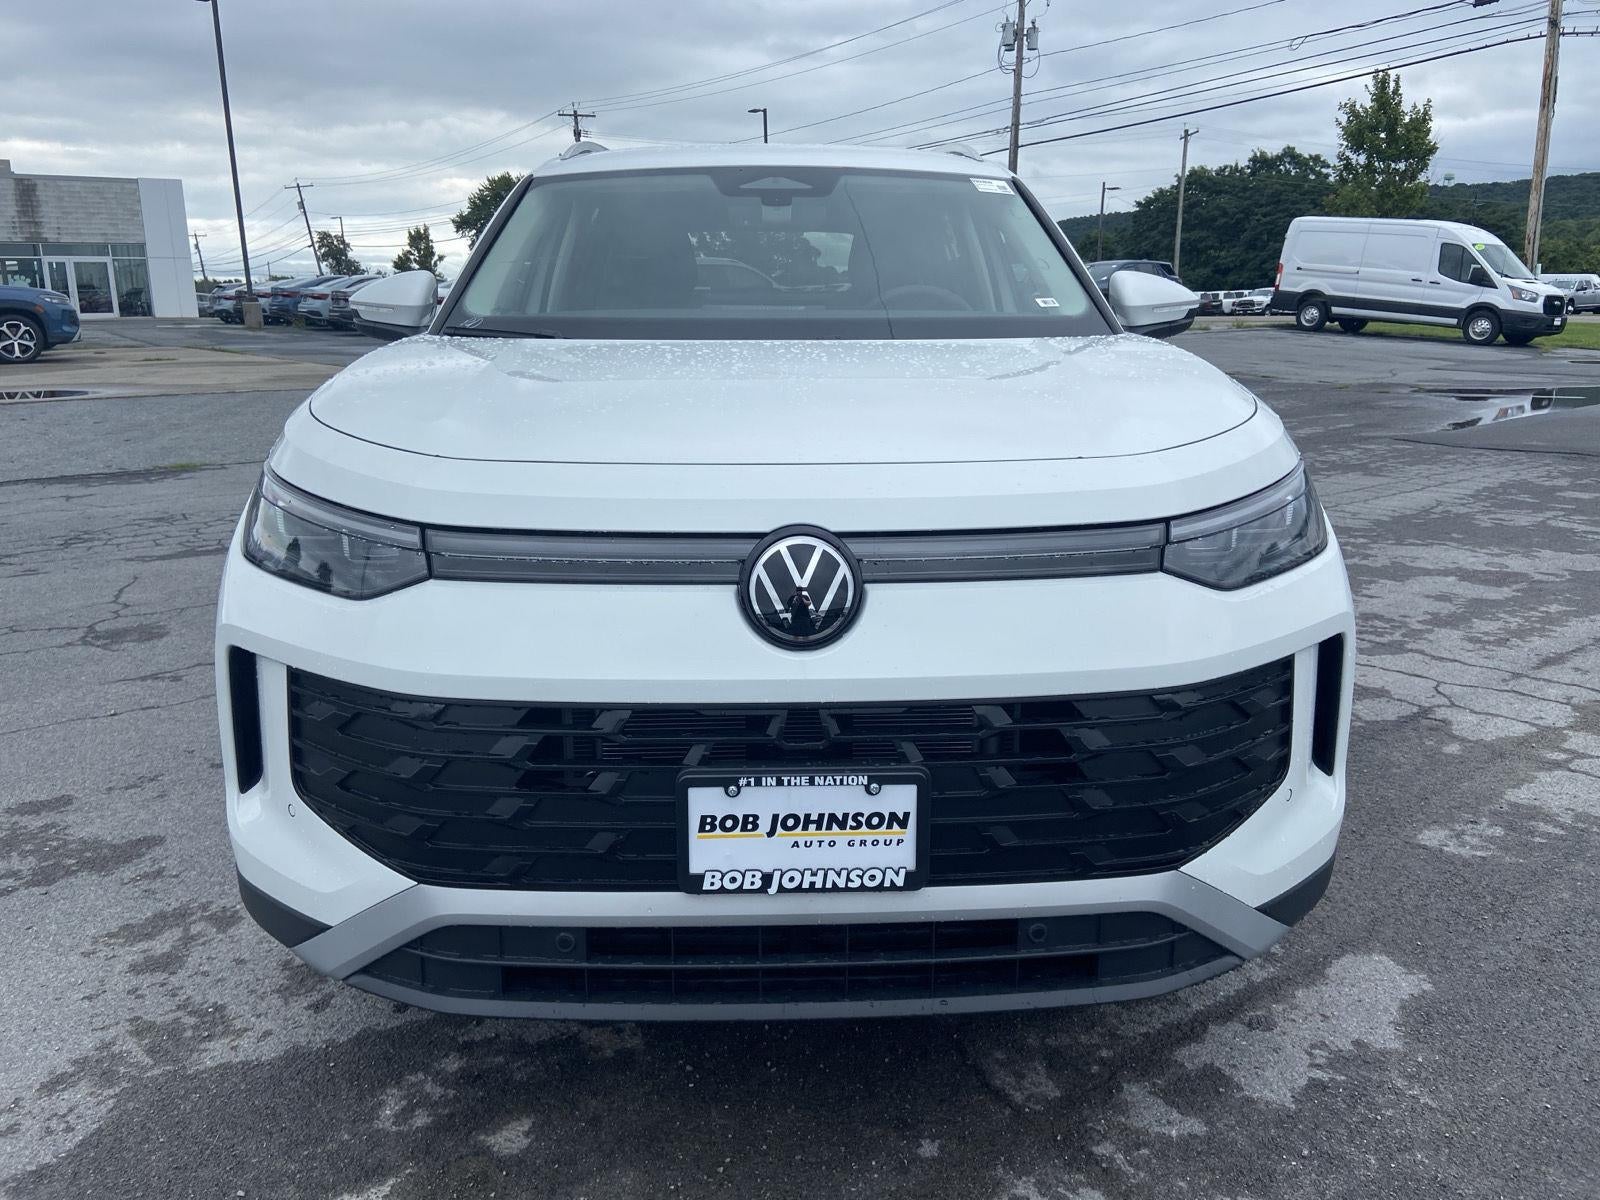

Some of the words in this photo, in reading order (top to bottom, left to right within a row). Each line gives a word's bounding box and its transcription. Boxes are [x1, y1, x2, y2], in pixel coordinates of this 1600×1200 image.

[738, 777, 755, 787] #1
[761, 776, 777, 786] IN
[781, 776, 810, 786] THE
[814, 775, 868, 786] NATION
[698, 813, 760, 834] BOB
[766, 811, 911, 838] JOHNSON
[791, 840, 837, 849] AUTO
[847, 838, 905, 848] GROUP
[702, 870, 763, 890] BOB
[767, 868, 906, 894] JOHNSON
